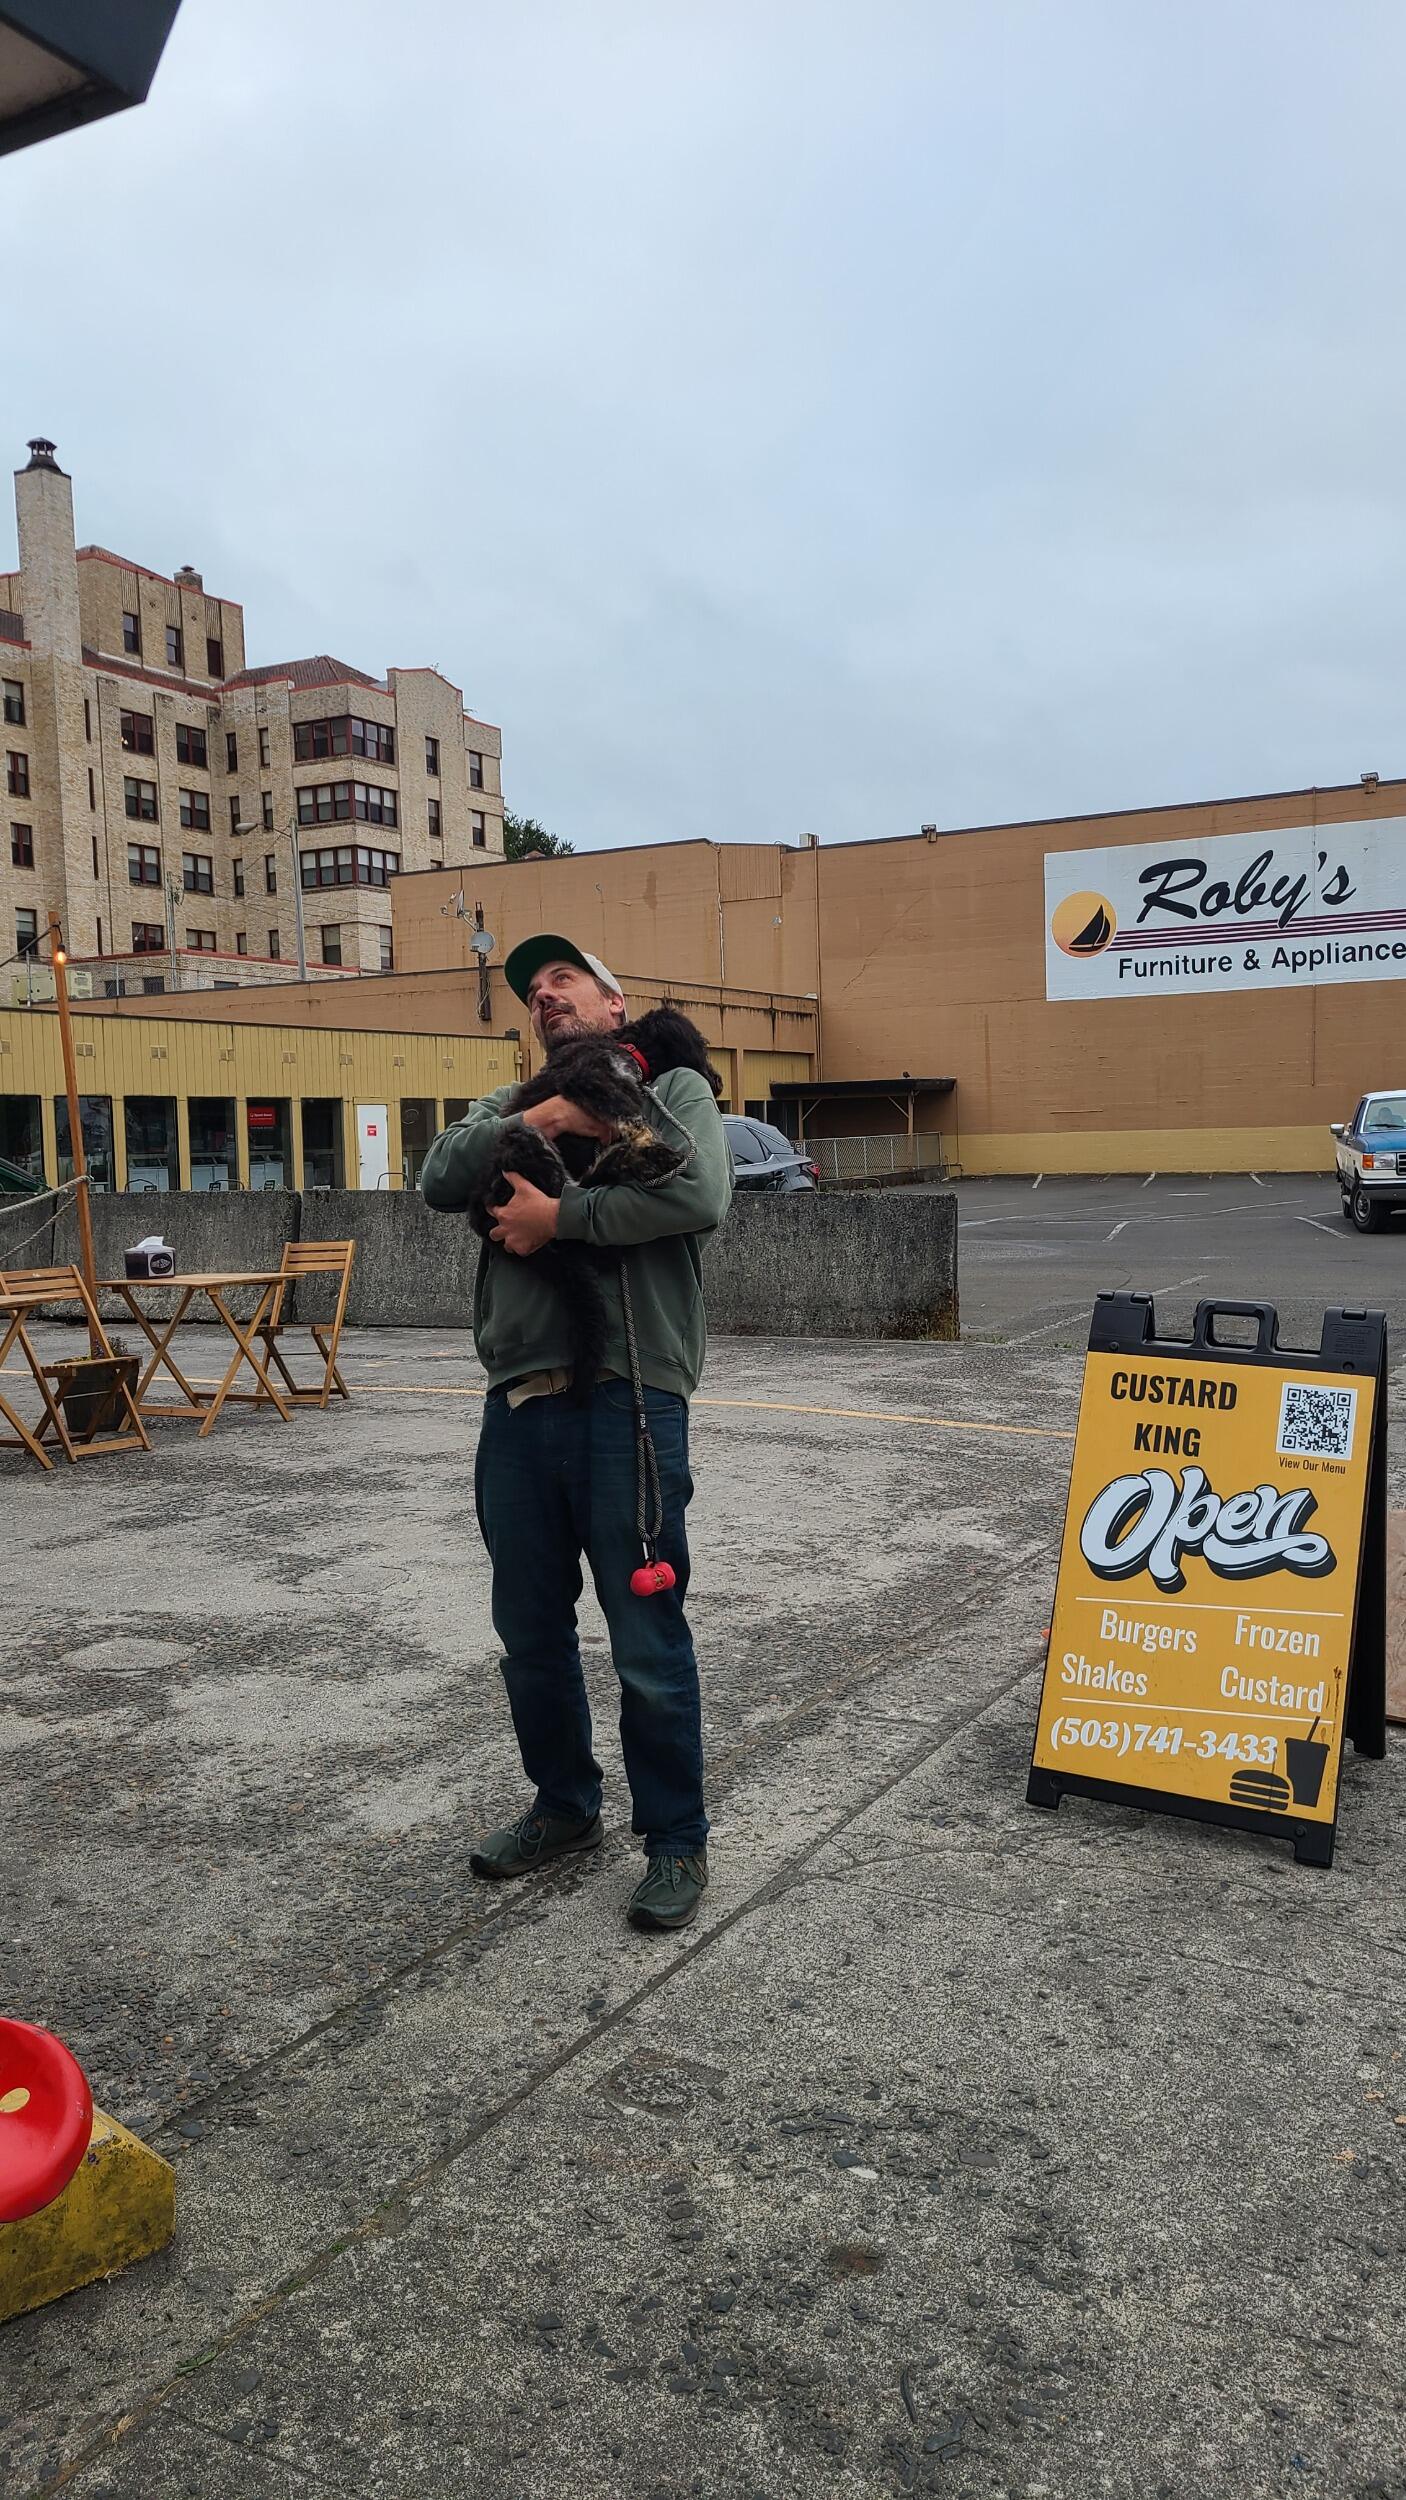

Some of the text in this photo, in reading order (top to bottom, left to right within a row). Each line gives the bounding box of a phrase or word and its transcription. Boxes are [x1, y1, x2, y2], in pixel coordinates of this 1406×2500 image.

[1136, 850, 1356, 929] Roby's
[1118, 942, 1406, 979] Furniture & Appliance
[1110, 1371, 1238, 1410] CUSTARD
[1133, 1422, 1201, 1457] KING
[1279, 1457, 1346, 1475] View Our Menu
[1080, 1465, 1337, 1594] Open
[1100, 1609, 1198, 1653] Burgers
[1234, 1614, 1320, 1657] Frozen
[1061, 1653, 1148, 1696] Shakes
[1220, 1666, 1325, 1712] Custard
[1050, 1716, 1278, 1764] (503)741-3433
